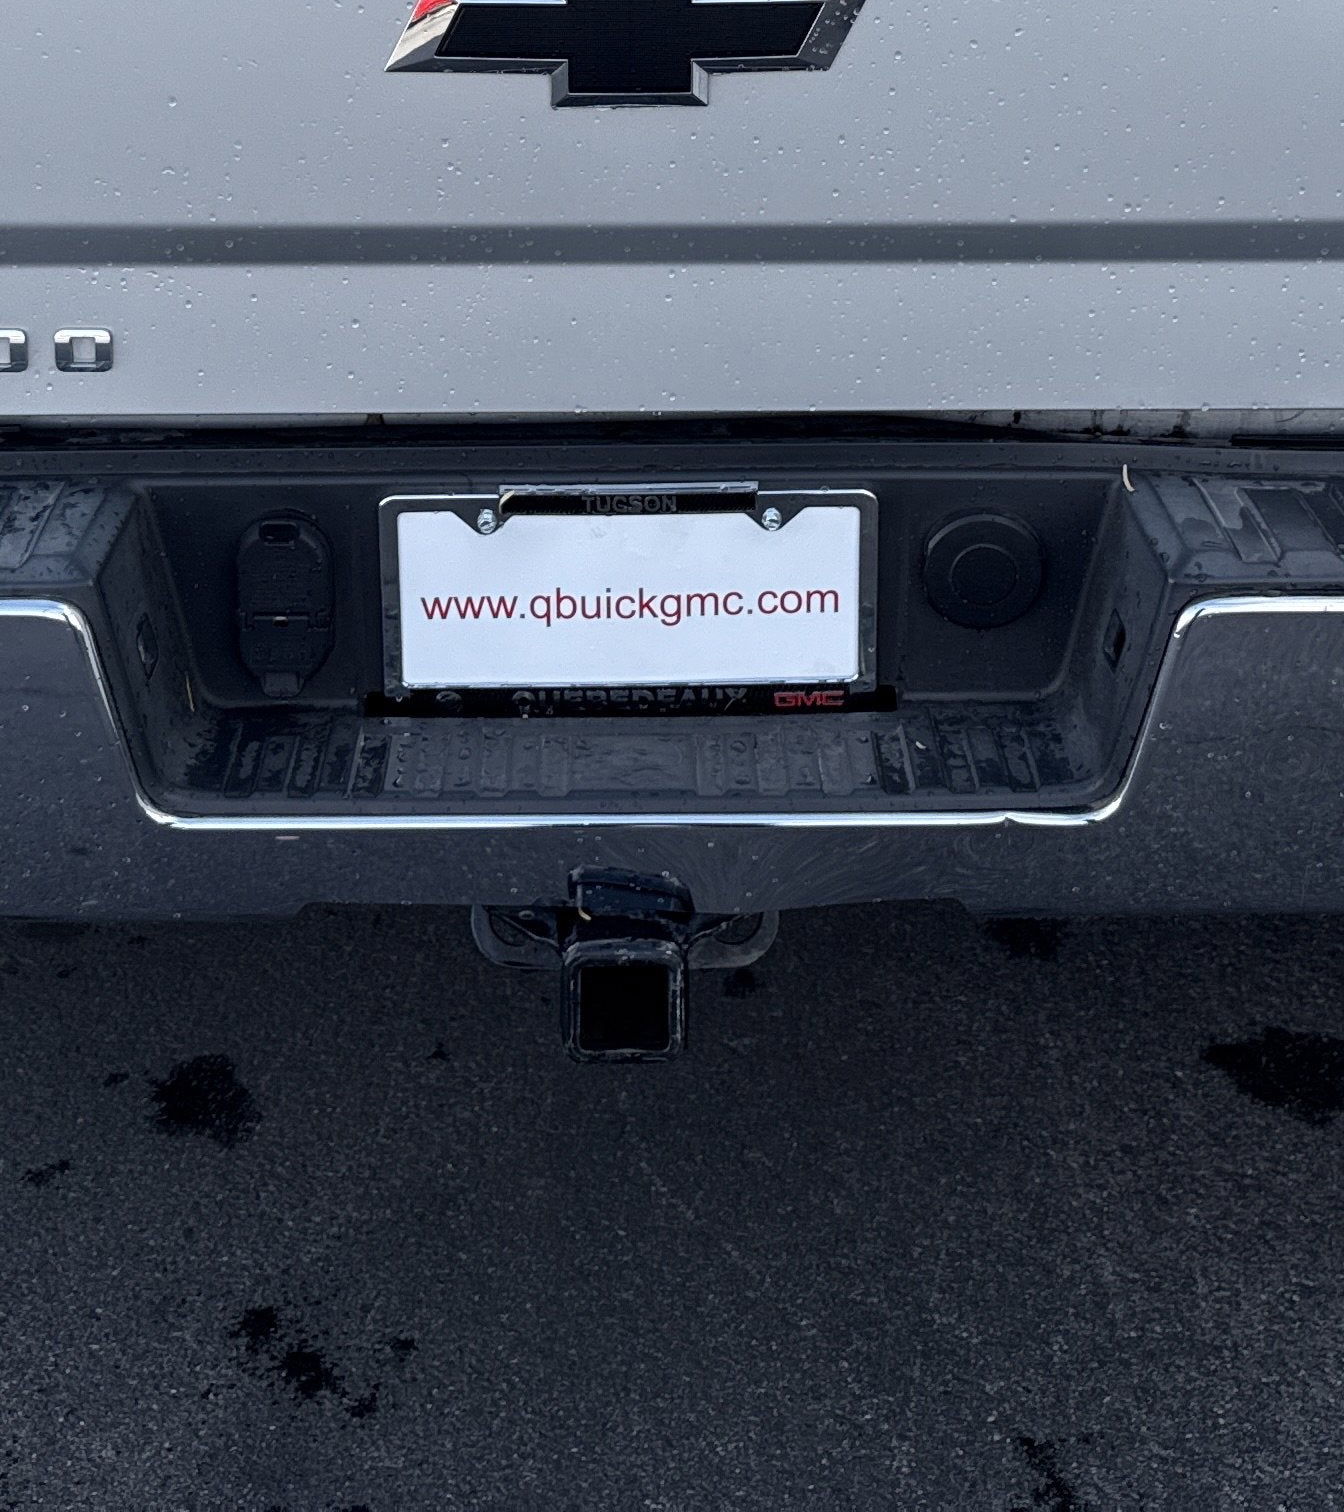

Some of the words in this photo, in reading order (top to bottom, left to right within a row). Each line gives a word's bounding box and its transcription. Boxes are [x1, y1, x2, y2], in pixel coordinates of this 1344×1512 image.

[581, 494, 677, 513] TUCSON
[420, 587, 840, 627] www.qbuickgmc.com
[774, 690, 844, 707] GMC
